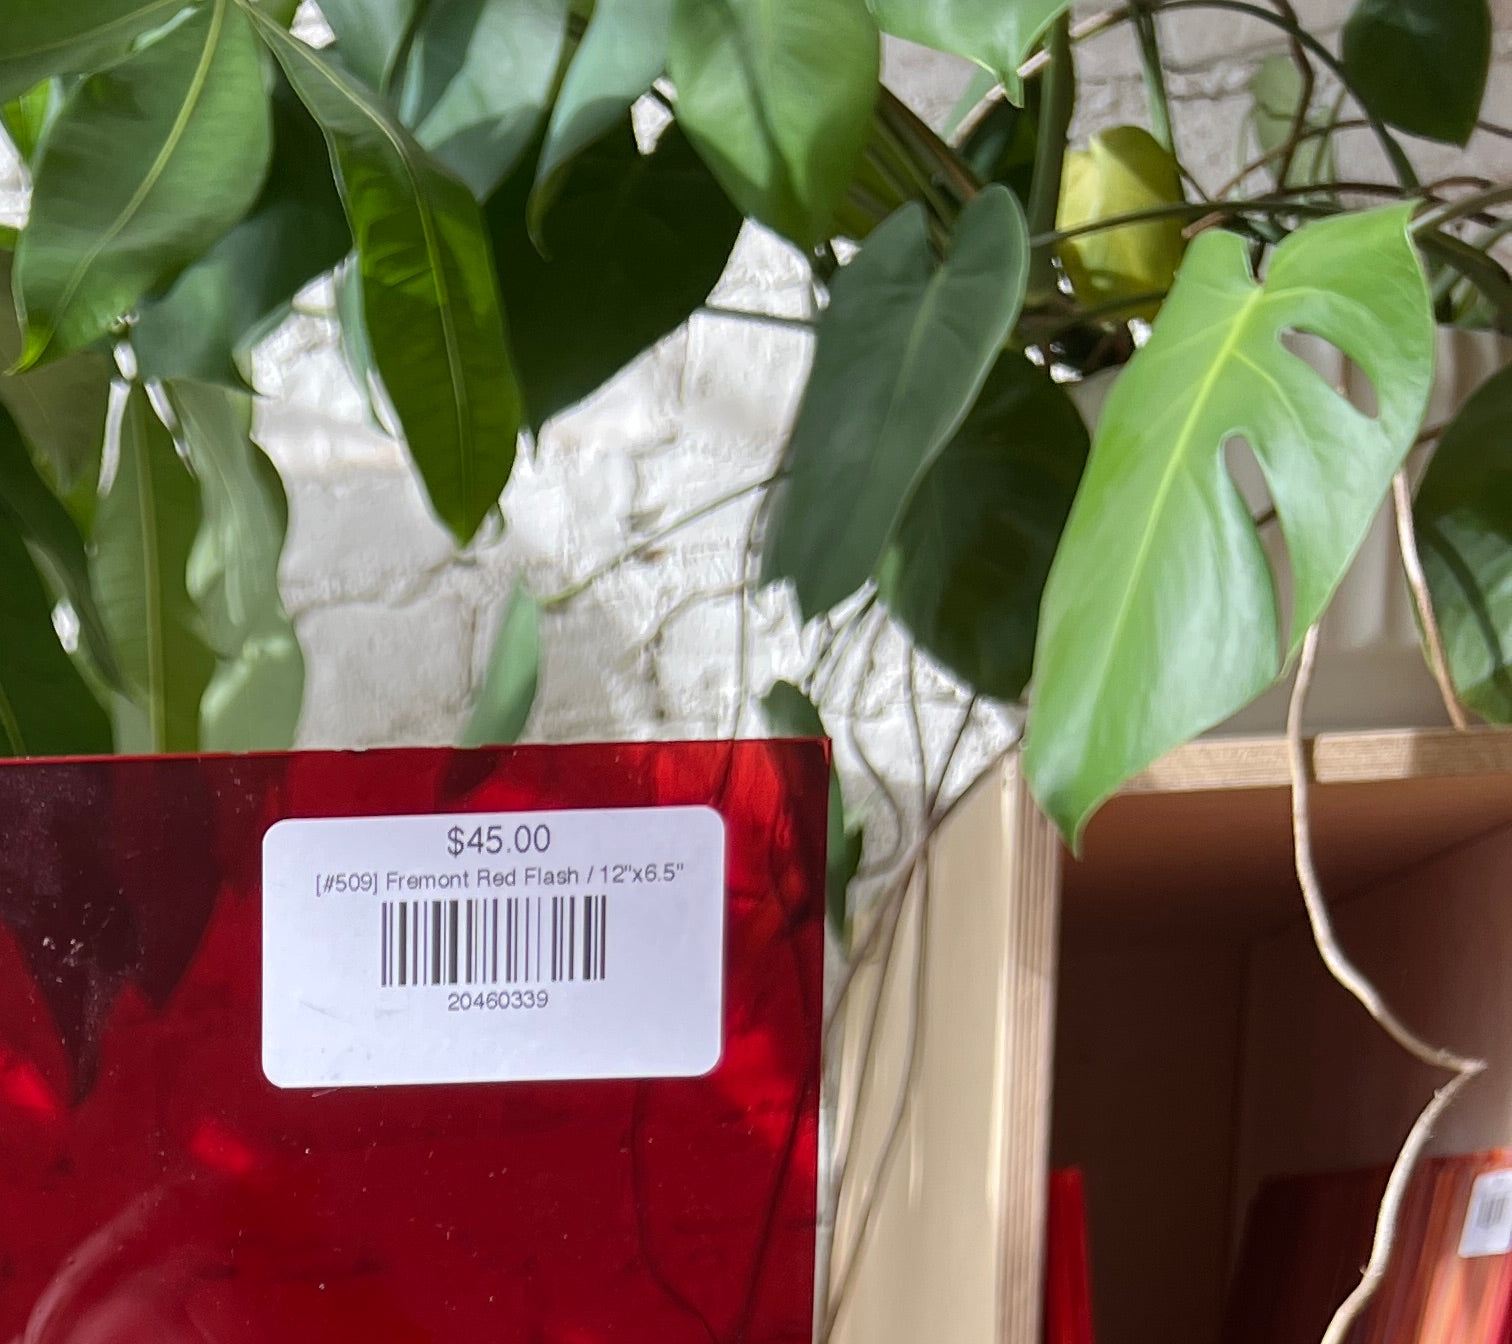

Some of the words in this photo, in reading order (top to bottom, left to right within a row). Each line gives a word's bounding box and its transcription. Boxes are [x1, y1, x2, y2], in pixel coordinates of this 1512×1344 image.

[446, 823, 552, 858] $45.00
[315, 872, 378, 898] [#509]
[386, 869, 469, 891] Fremont
[477, 868, 516, 889] Red
[524, 866, 579, 886] Flash
[586, 865, 594, 885] /
[600, 862, 684, 884] 12"x6.5"
[447, 989, 549, 1013] 20460339
